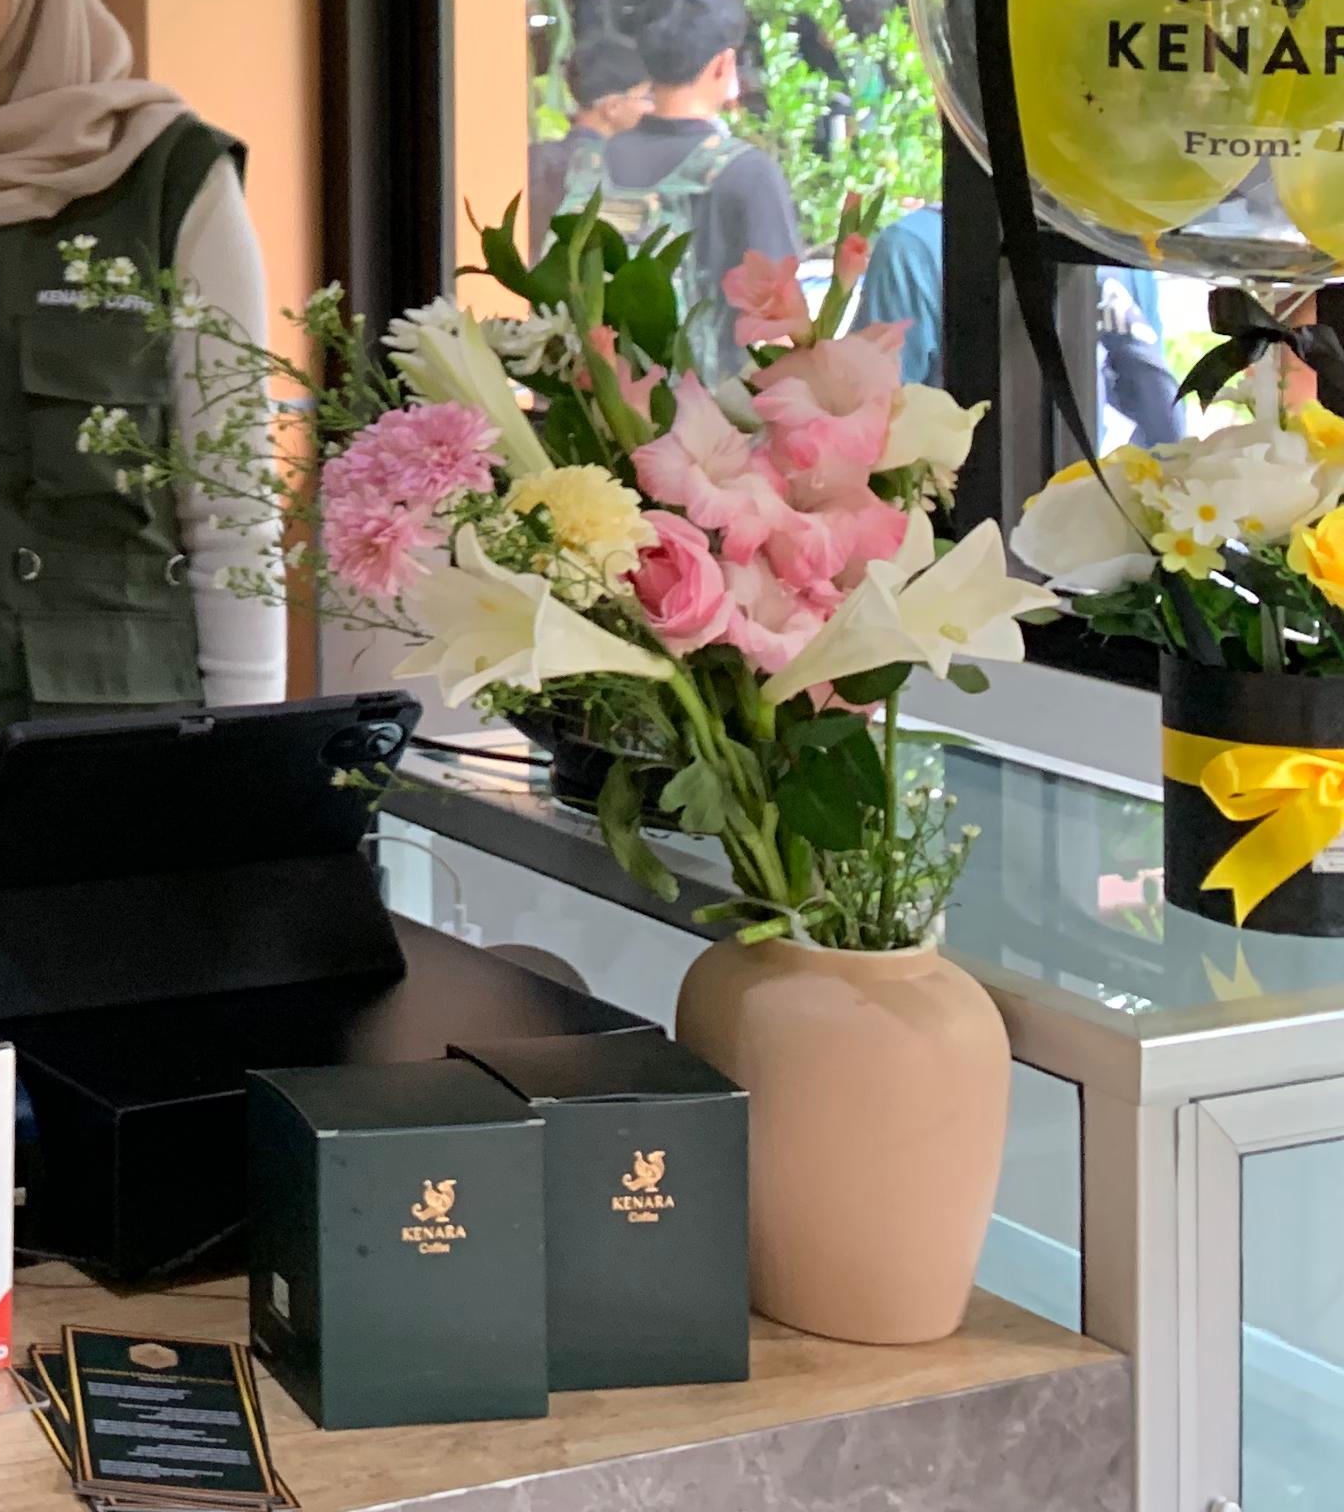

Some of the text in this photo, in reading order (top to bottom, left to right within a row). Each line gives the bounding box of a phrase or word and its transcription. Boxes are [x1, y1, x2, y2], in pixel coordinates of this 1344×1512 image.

[1184, 130, 1302, 158] From:
[611, 1194, 675, 1211] KENARA
[400, 1224, 467, 1242] KENARA
